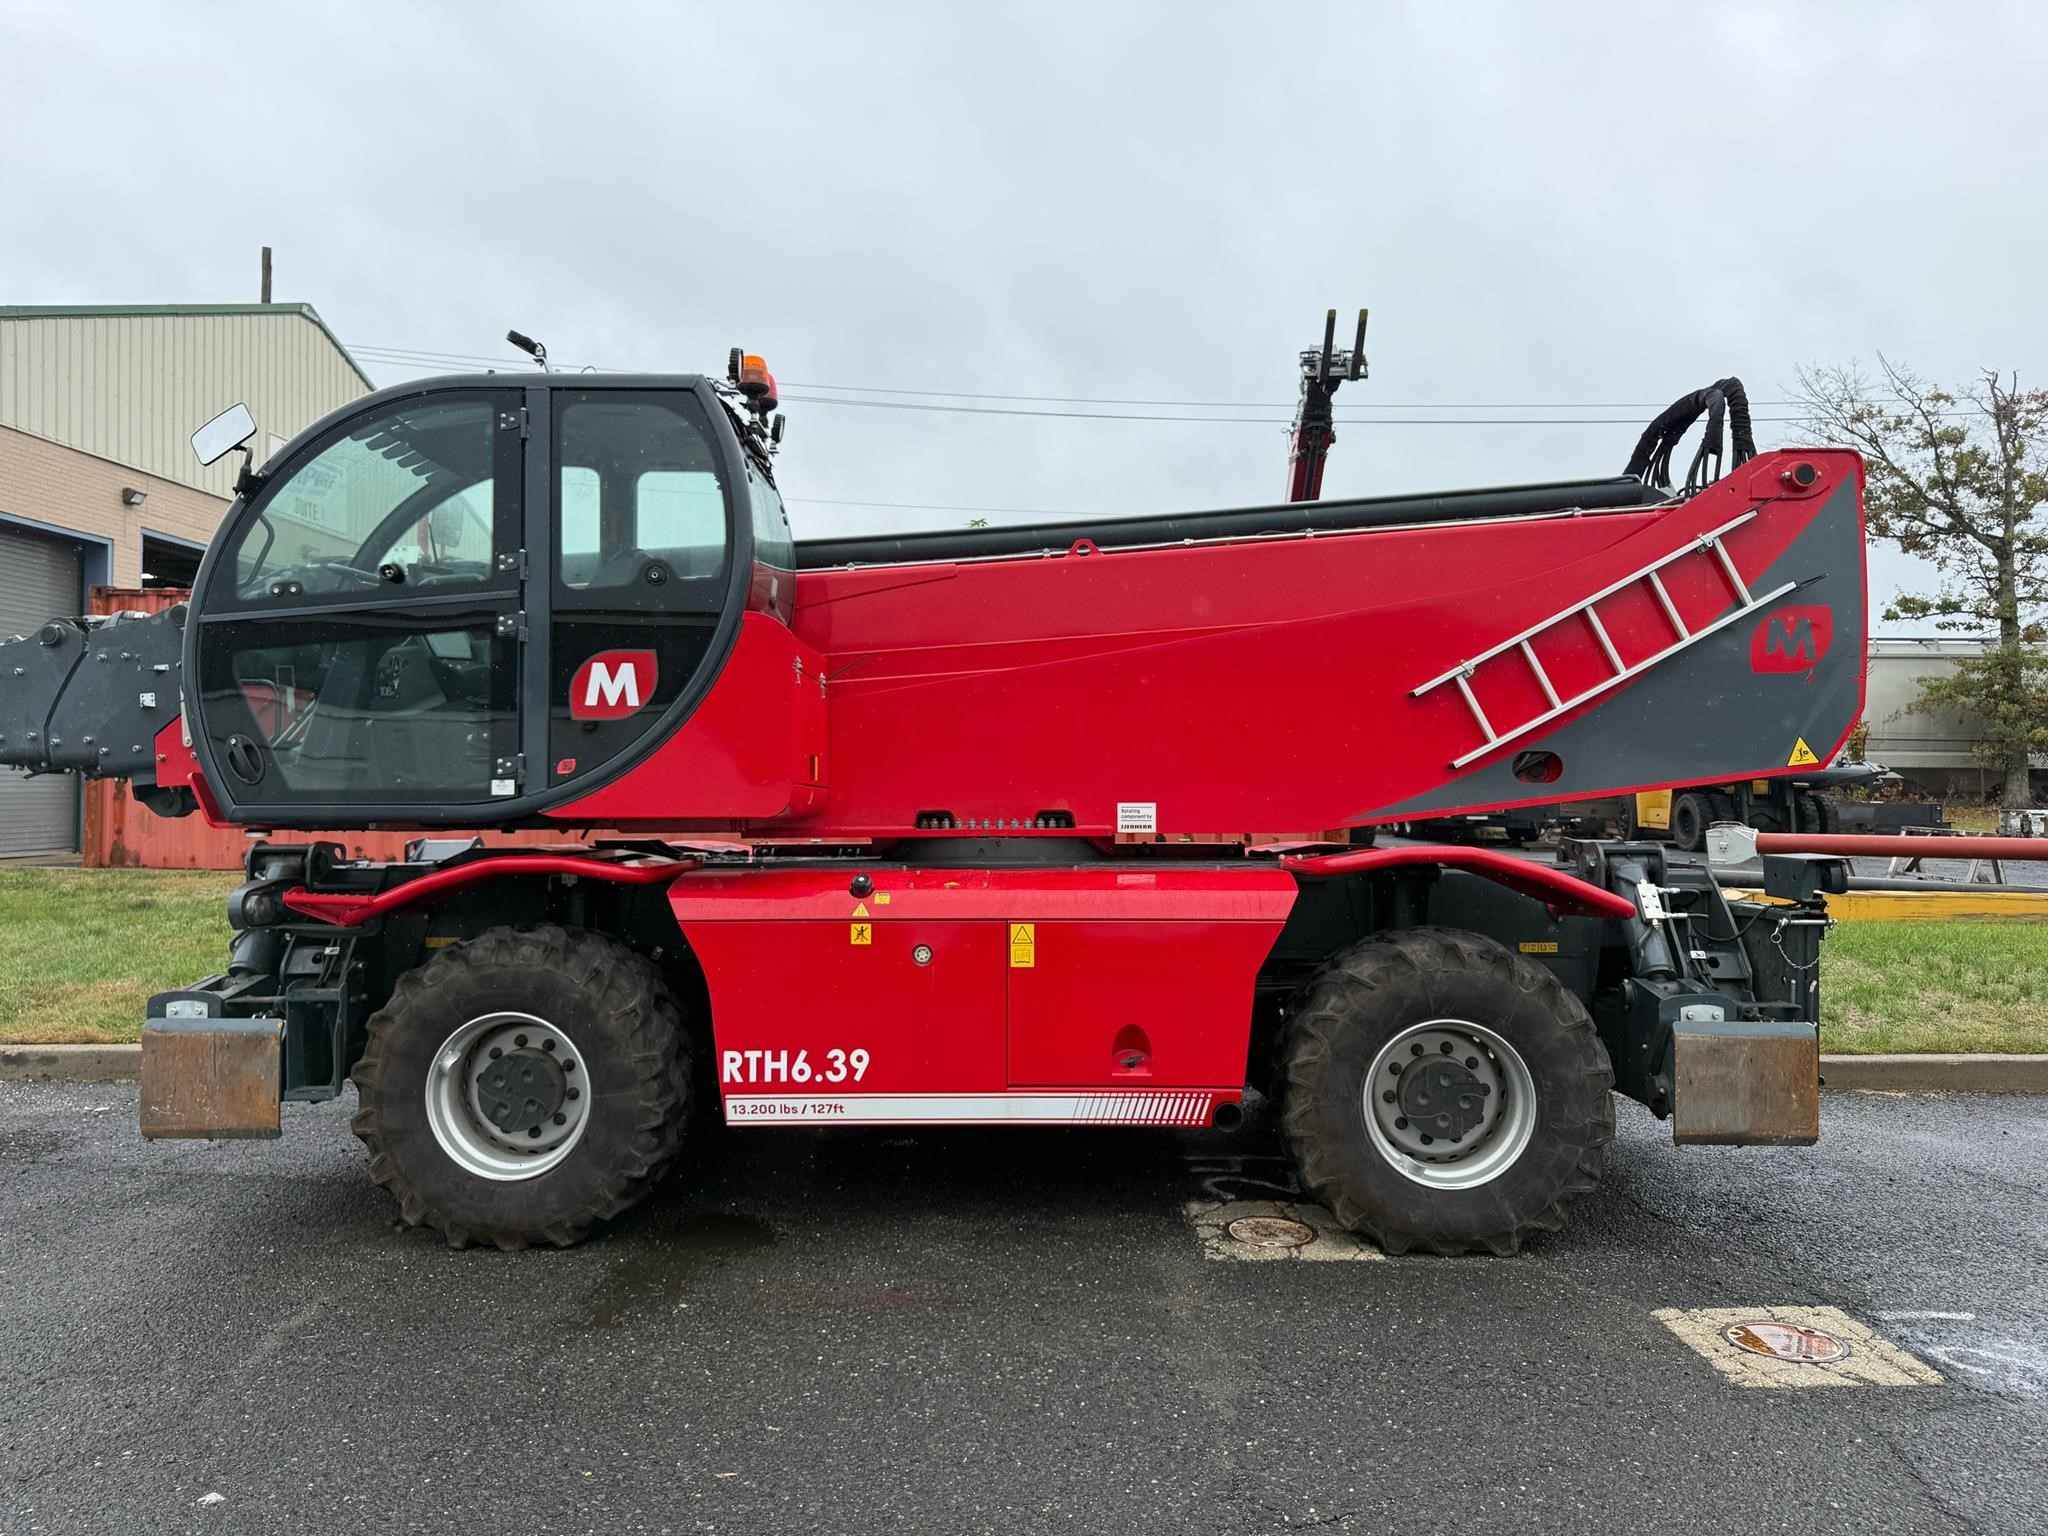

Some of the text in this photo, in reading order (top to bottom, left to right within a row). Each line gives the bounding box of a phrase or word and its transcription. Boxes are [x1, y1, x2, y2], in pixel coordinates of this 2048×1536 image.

[1767, 618, 1816, 661] M
[584, 662, 640, 707] M
[723, 1048, 870, 1083] RTH6.39
[731, 1104, 776, 1115] 13.200
[779, 1103, 798, 1114] lbs
[811, 1103, 845, 1114] 127ft
